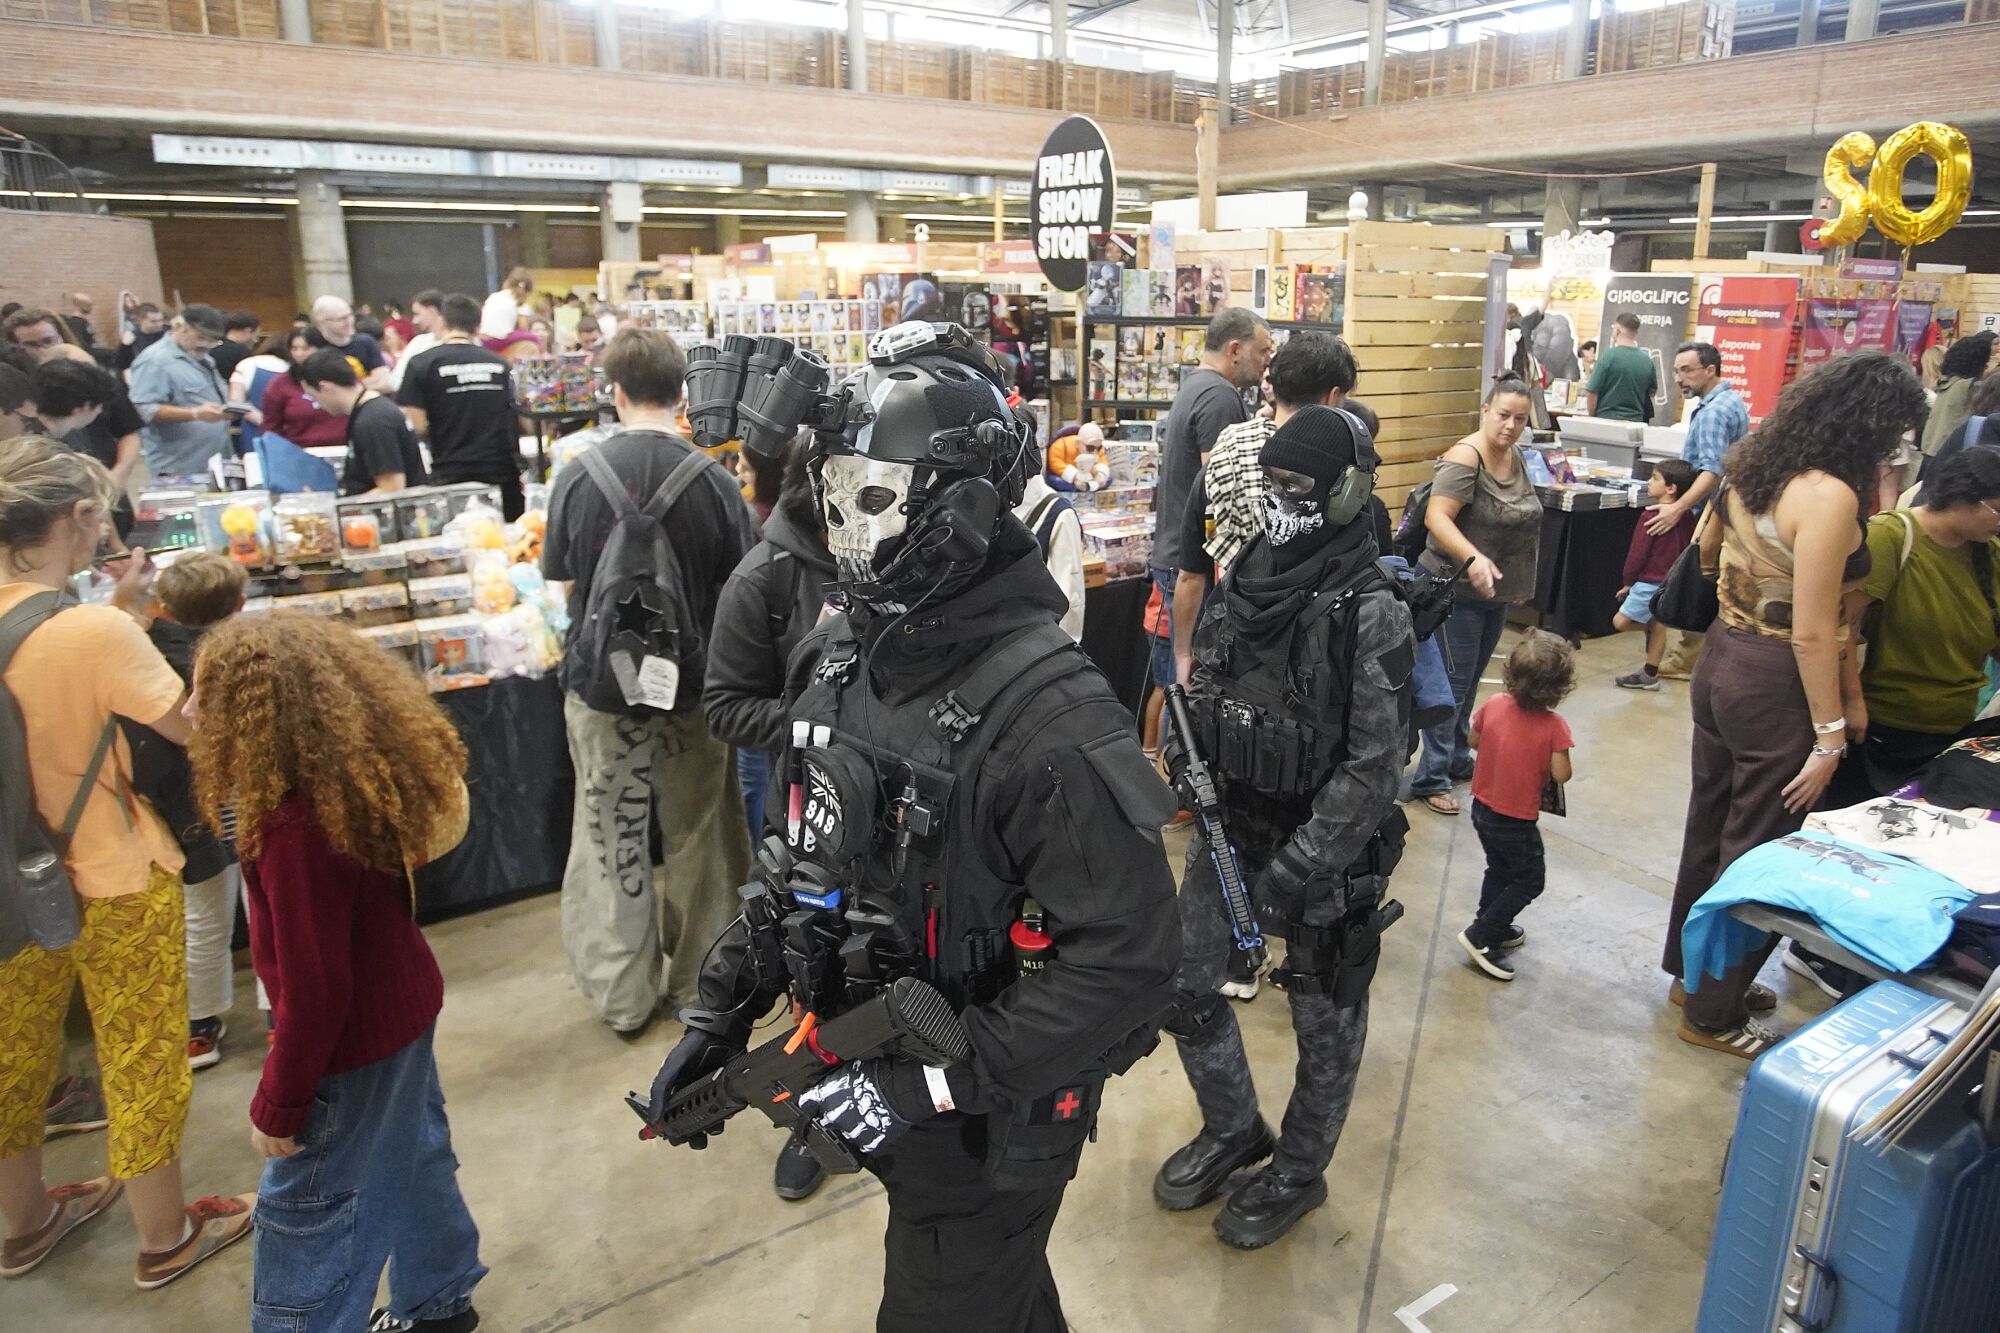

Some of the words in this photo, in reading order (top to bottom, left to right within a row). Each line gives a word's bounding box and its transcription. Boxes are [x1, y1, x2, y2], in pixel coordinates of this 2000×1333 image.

[1038, 149, 1104, 189] FREAK
[1039, 187, 1103, 225] SHOW
[1038, 225, 1102, 260] STOR
[1718, 339, 1762, 351] Japonès
[805, 799, 836, 835] SAS
[1022, 959, 1045, 970] M18
